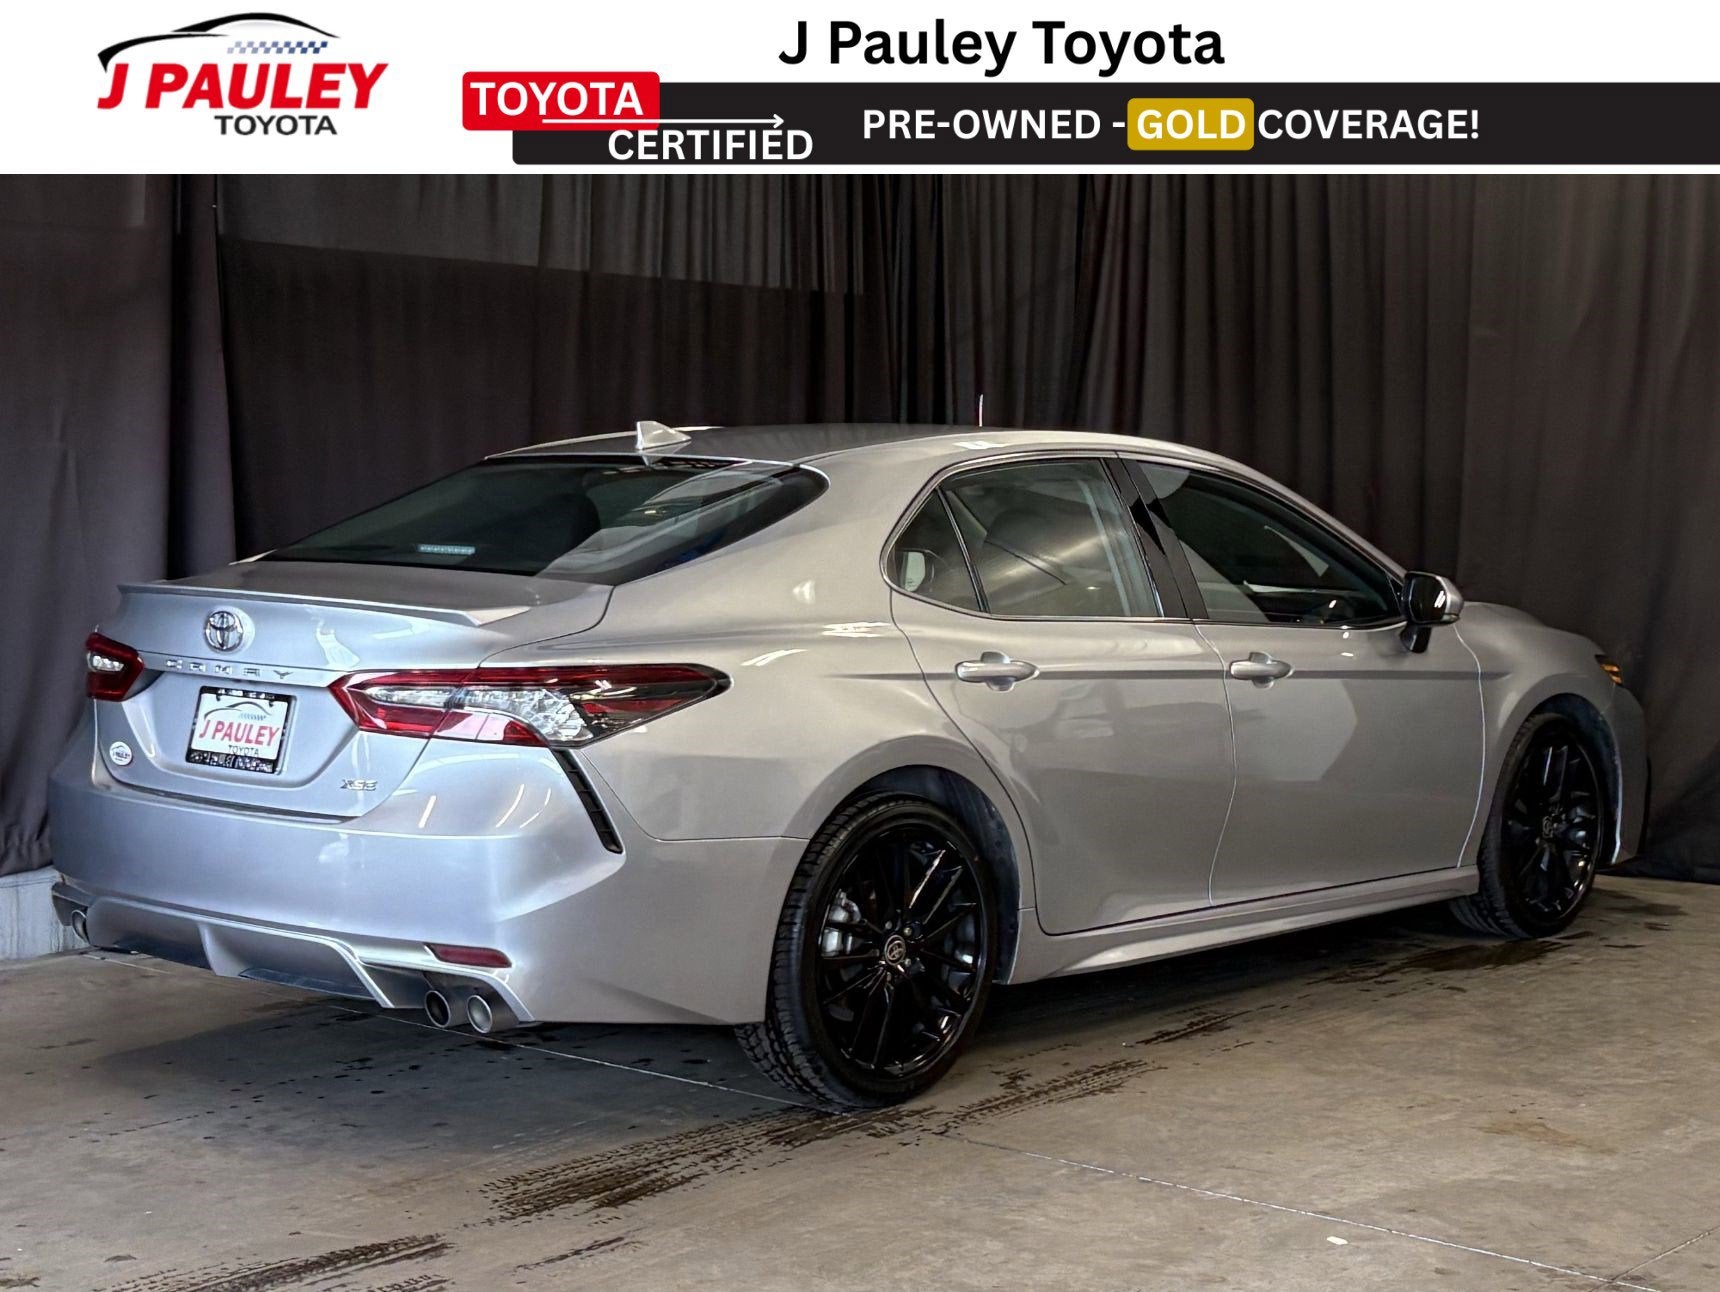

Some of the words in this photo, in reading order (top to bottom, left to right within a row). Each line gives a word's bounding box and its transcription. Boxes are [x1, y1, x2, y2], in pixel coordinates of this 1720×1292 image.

[199, 719, 211, 739] J
[211, 720, 280, 746] PAULEY
[228, 744, 259, 757] TOYOTA
